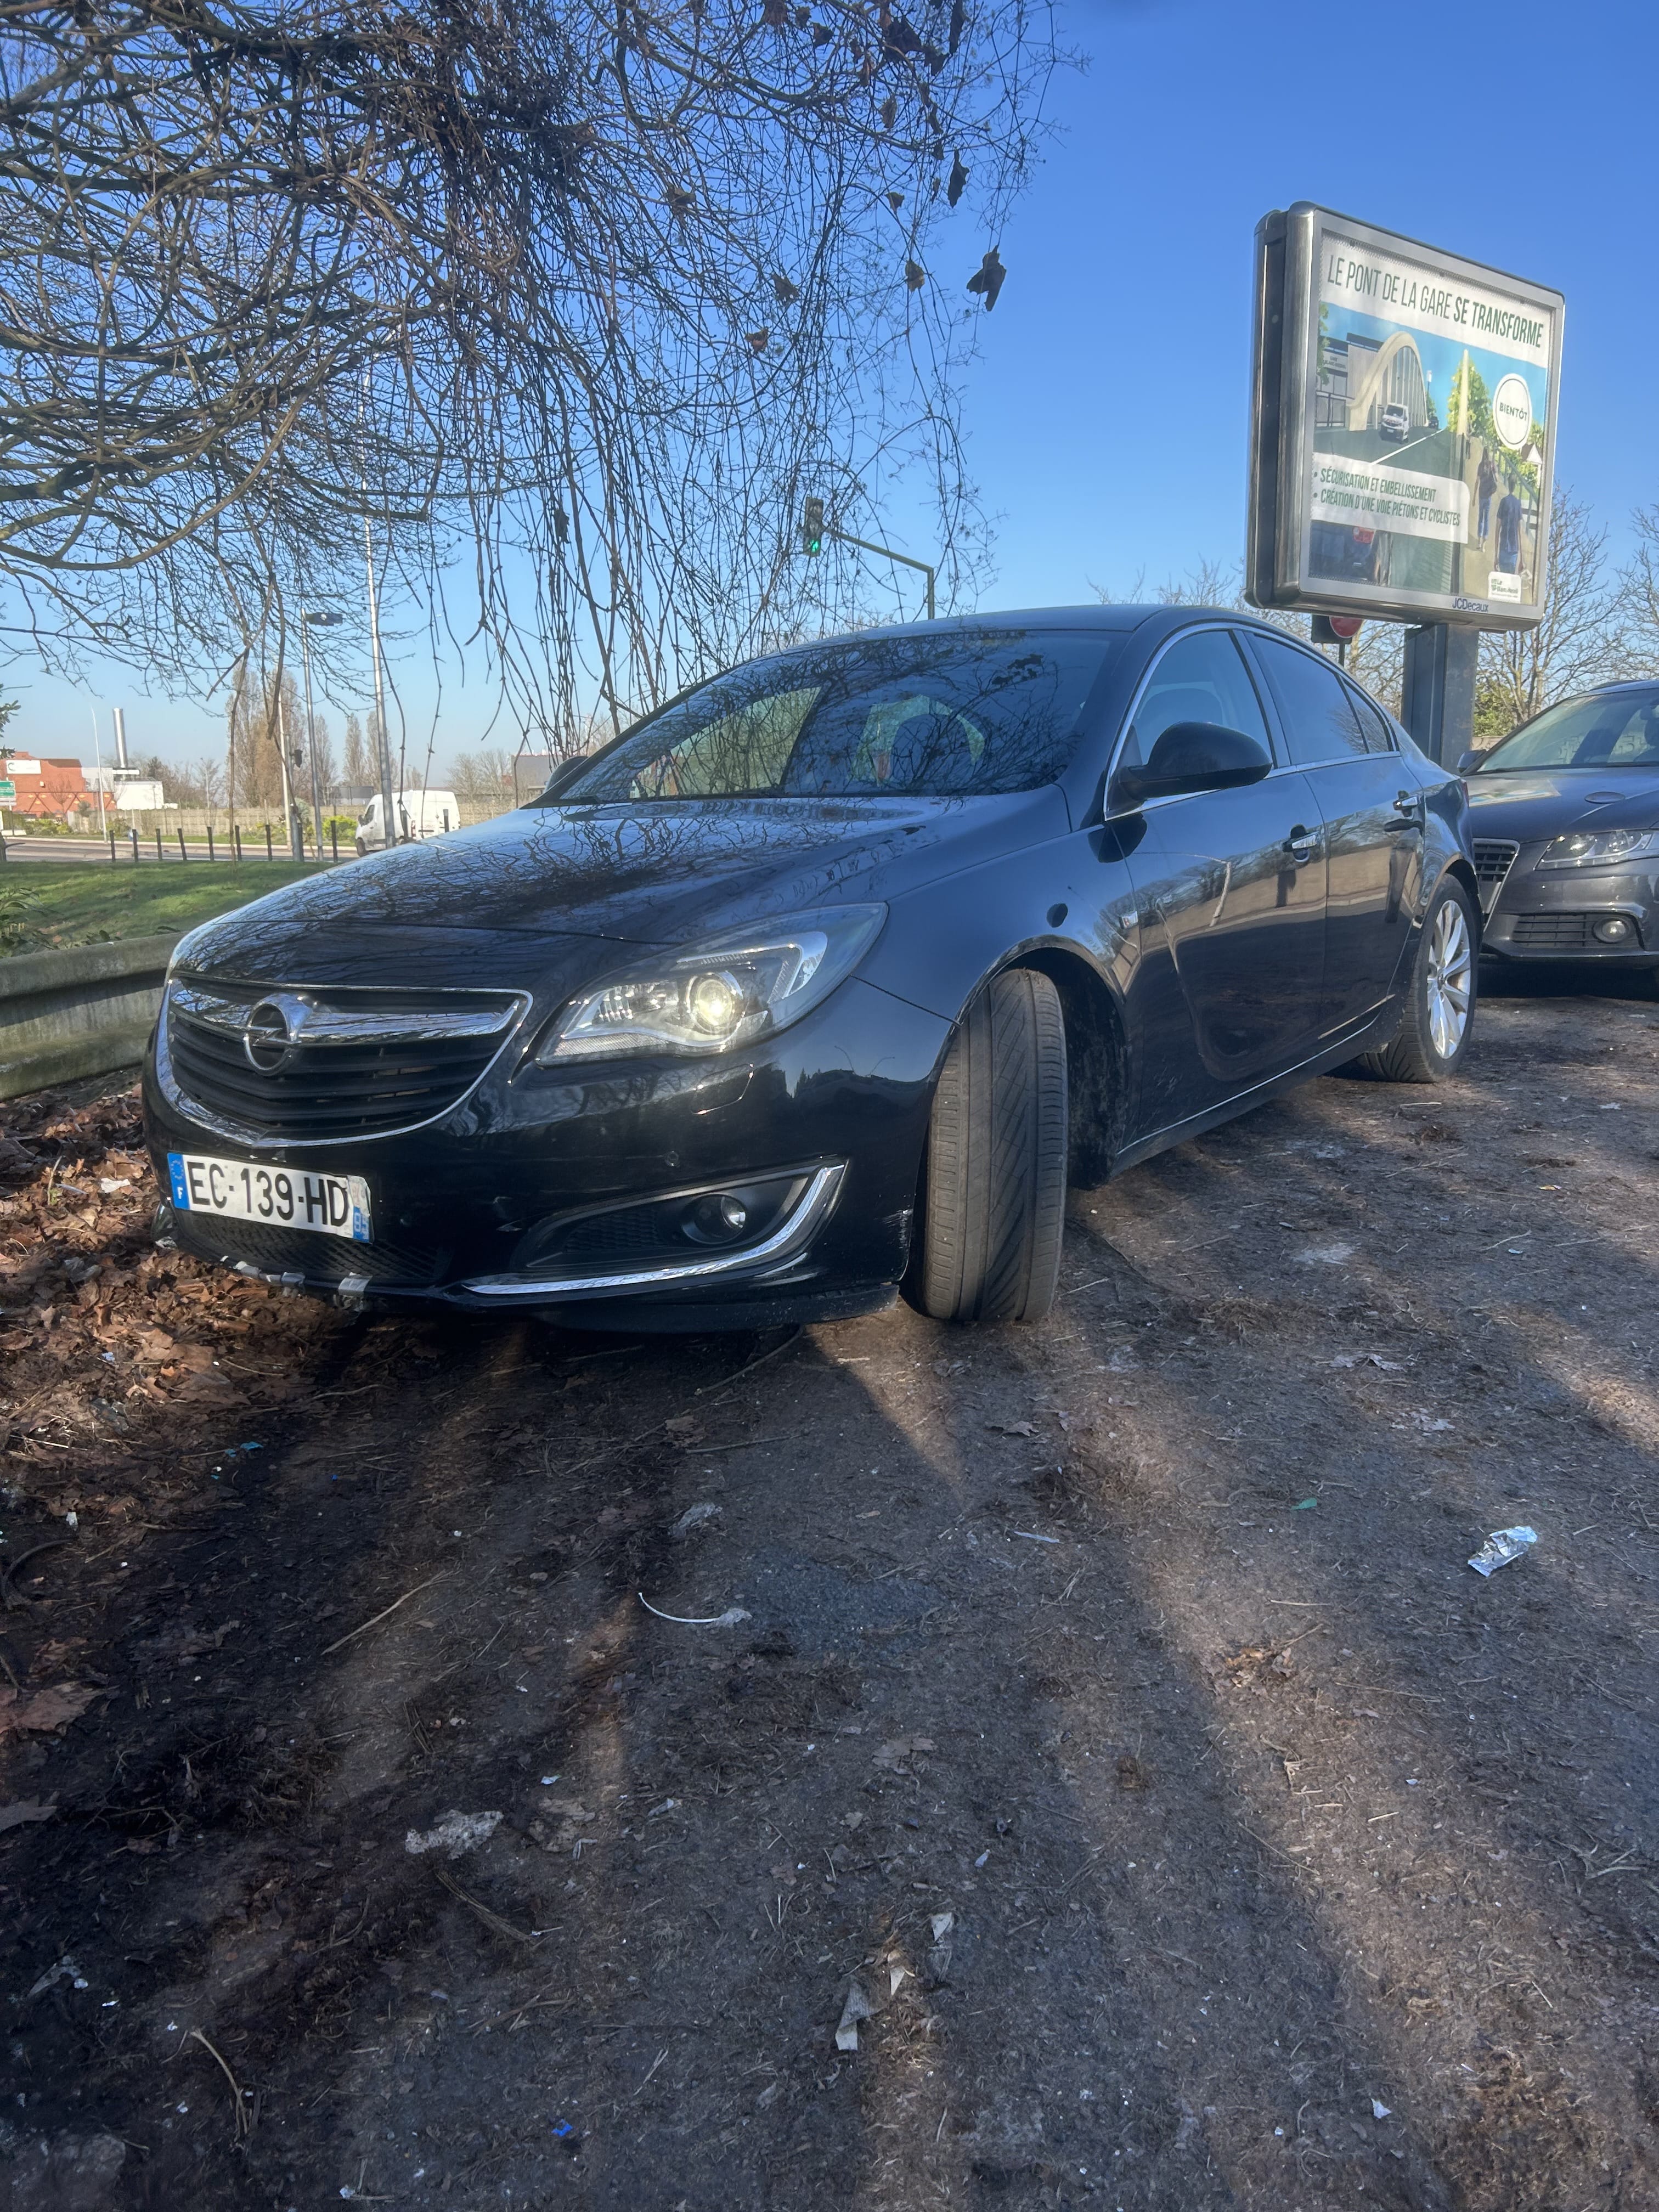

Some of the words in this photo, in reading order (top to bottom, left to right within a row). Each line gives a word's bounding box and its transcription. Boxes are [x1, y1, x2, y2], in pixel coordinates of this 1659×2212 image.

[1327, 254, 1345, 286] LE
[1346, 261, 1381, 297] PONT
[1382, 273, 1400, 303] DE
[1401, 278, 1417, 309] LA
[1420, 285, 1452, 319] GARE
[1453, 296, 1470, 325] SE
[1471, 301, 1544, 348] TRANSFORME
[1499, 402, 1528, 421] BIENTÔT
[1320, 466, 1370, 490] SÉCURISATION
[1370, 477, 1380, 492] ET
[1380, 479, 1436, 503] EMBELLISSEMENT
[1320, 488, 1355, 508] CRÉATION
[1376, 499, 1392, 515] VOIE
[1392, 500, 1419, 520] PIÉTONS
[1419, 506, 1429, 521] ET
[1428, 508, 1461, 527] CYCLISTES
[1452, 597, 1489, 613] JCDecaux
[177, 1187, 184, 1200] F
